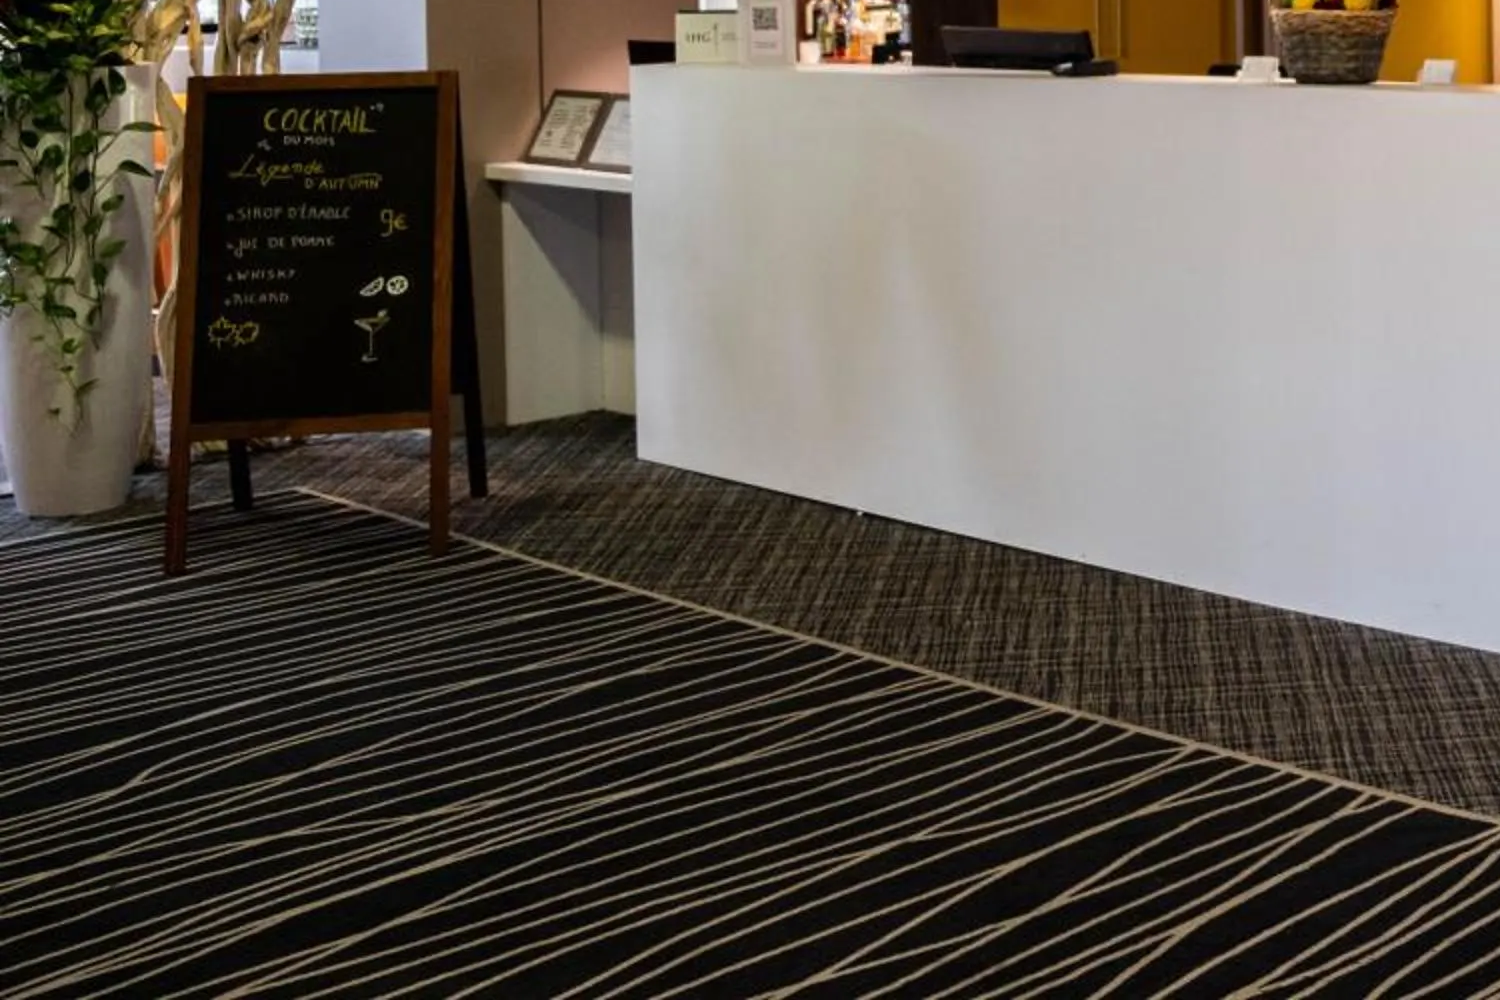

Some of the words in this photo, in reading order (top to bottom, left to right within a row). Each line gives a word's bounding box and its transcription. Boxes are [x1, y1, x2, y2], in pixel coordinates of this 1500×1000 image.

[263, 106, 377, 135] COCKTAIL
[283, 135, 301, 146] DU
[235, 205, 284, 221] SIROP
[267, 236, 286, 249] DE
